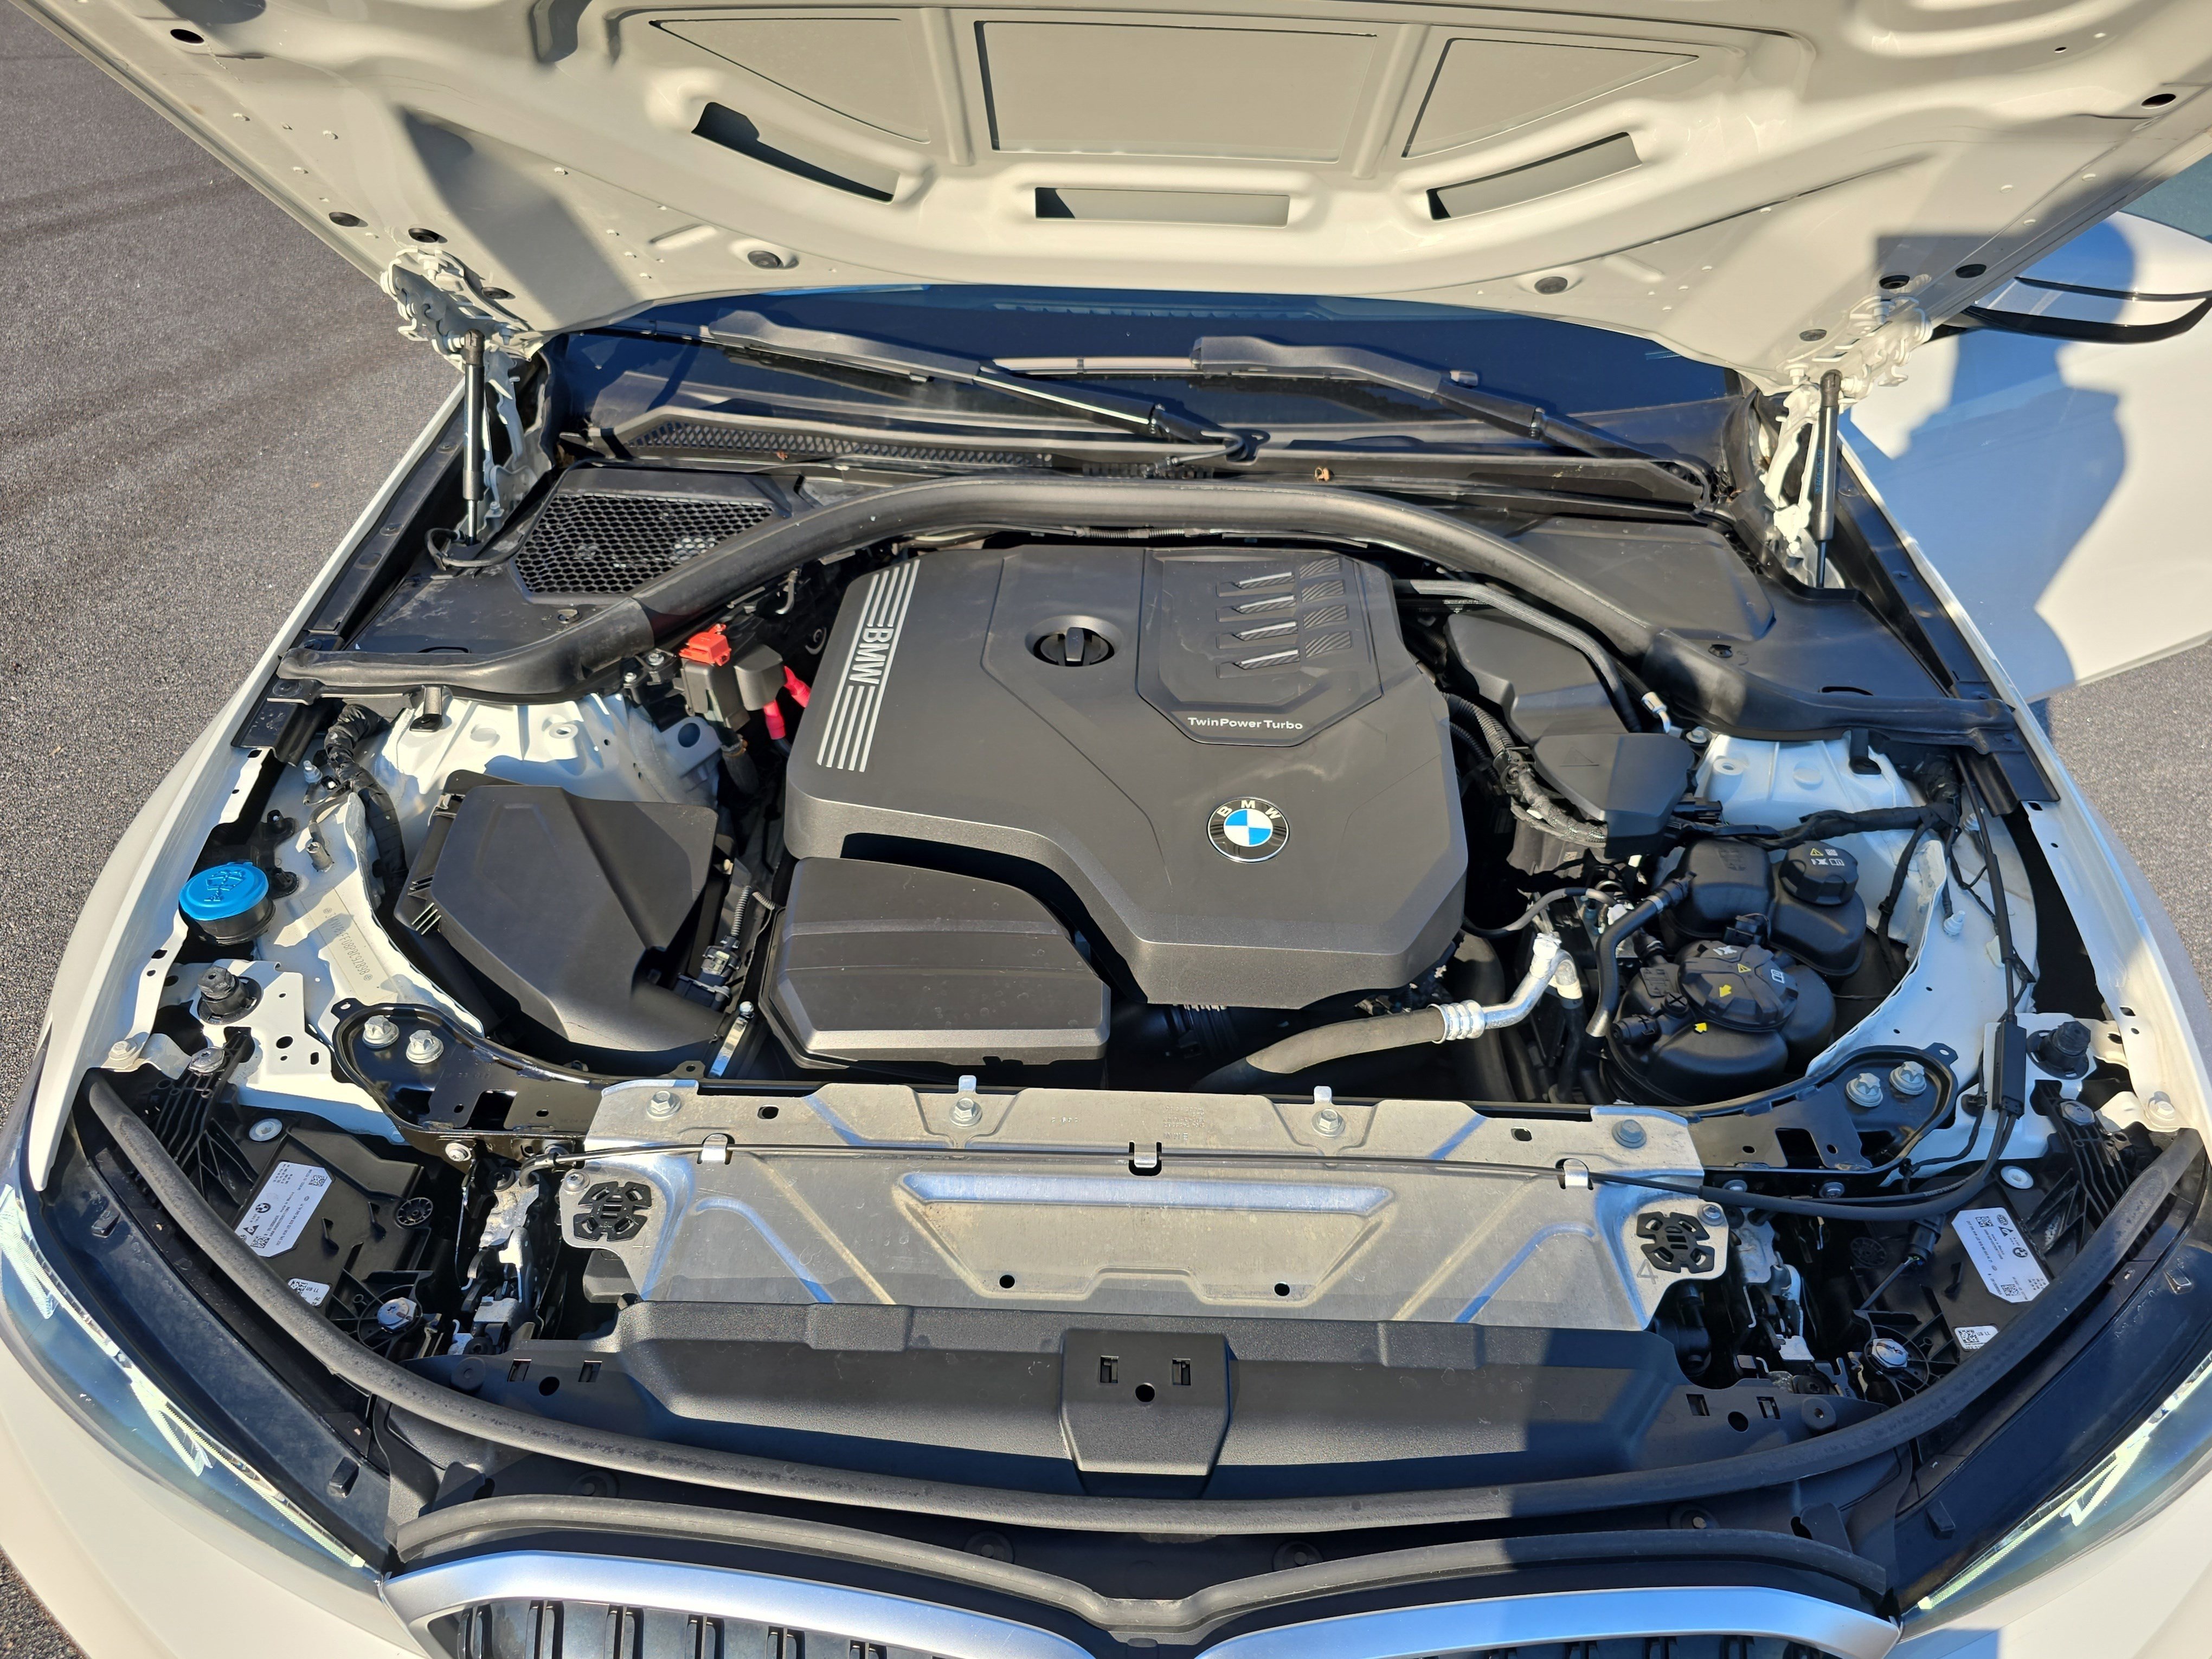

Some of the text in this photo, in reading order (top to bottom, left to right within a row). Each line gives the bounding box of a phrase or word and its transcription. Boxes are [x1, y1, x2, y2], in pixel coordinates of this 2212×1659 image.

[848, 626, 893, 685] BMW
[1187, 717, 1303, 730] TwinPower Turbo
[1216, 799, 1281, 820] BMW
